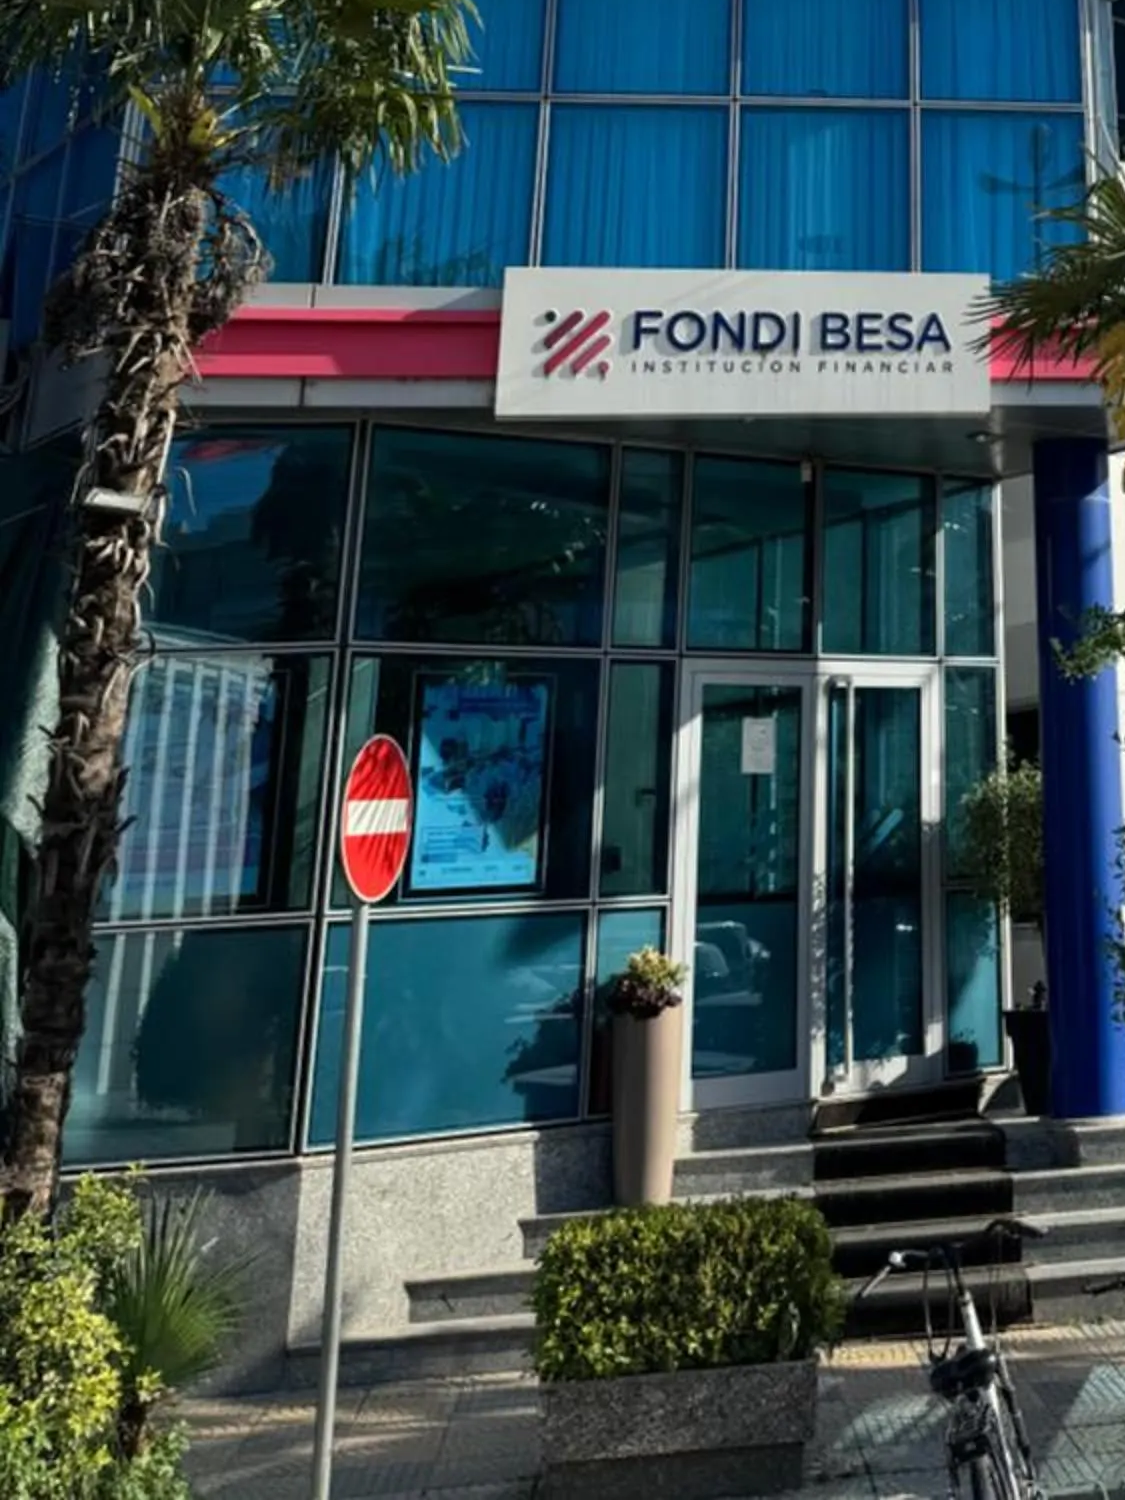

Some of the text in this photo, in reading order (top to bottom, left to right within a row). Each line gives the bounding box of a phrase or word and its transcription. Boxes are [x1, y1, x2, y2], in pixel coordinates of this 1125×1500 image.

[632, 310, 951, 355] FONDI BESA
[631, 359, 954, 374] INSTITUCION FINANCIAR
